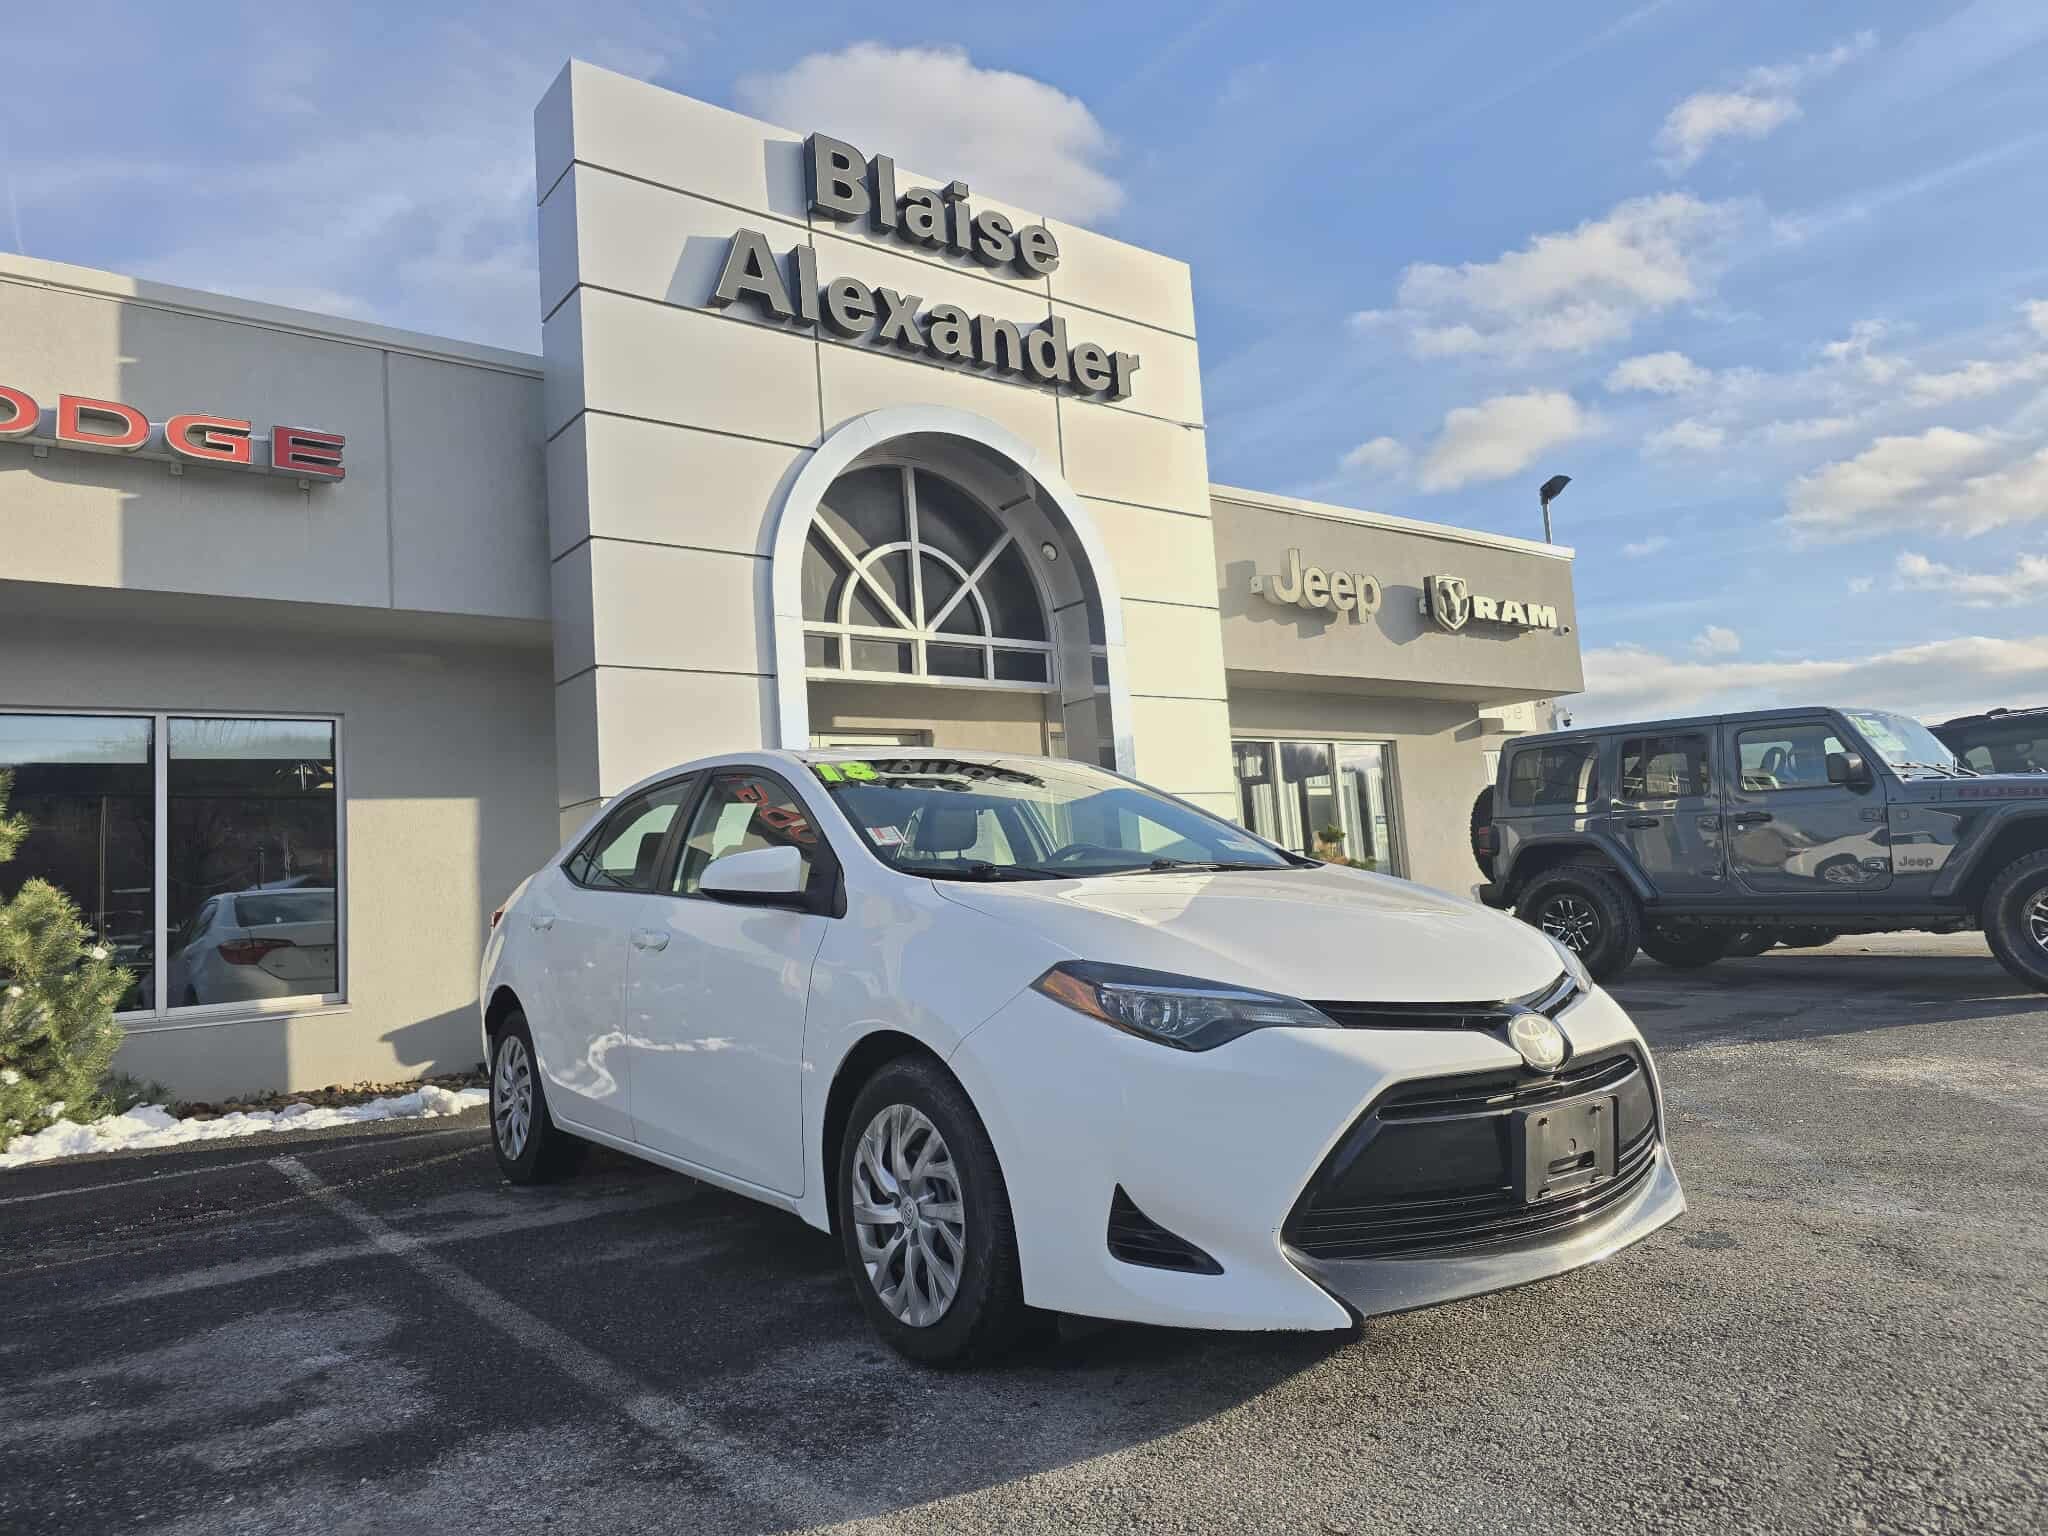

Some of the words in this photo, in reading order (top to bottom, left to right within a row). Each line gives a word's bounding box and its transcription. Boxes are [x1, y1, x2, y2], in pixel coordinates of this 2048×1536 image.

[803, 131, 1061, 280] Blaise
[708, 227, 1140, 402] Alexander
[1270, 547, 1382, 624] Jeep
[1471, 594, 1558, 629] RAM
[815, 760, 881, 783] 18
